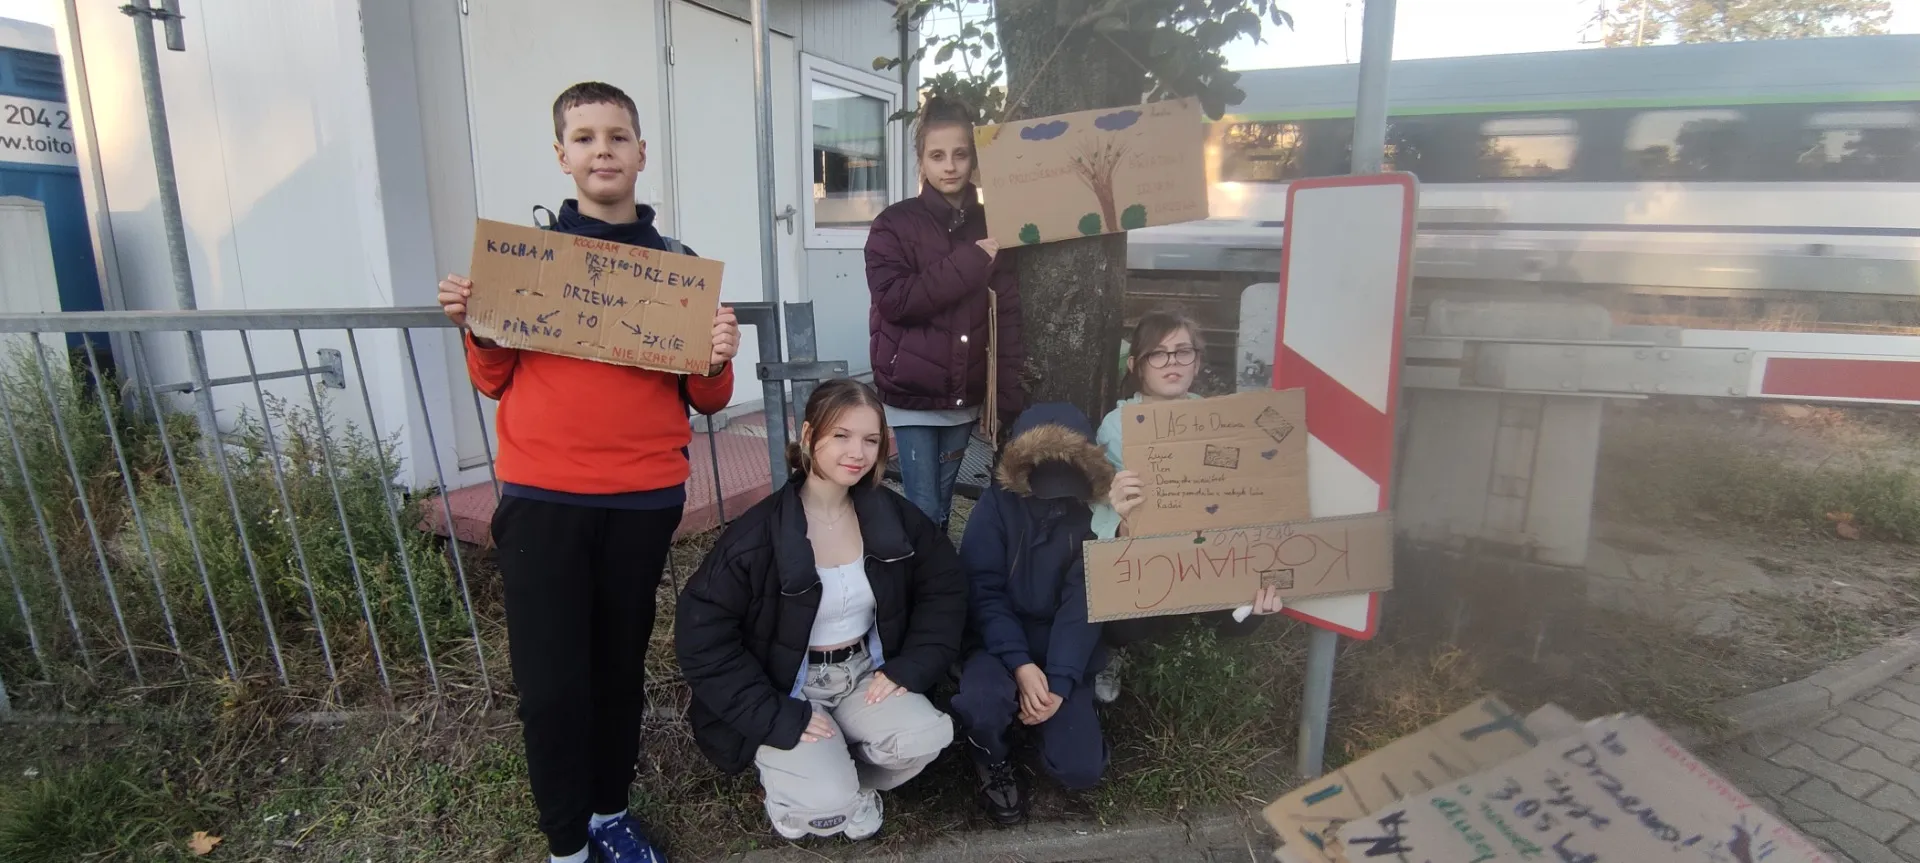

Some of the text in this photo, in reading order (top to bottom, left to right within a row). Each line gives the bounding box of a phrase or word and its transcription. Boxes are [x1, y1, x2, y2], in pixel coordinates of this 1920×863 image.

[5, 104, 51, 128] 204
[487, 240, 554, 261] KOCHAM
[573, 237, 619, 253] KOCHAM
[563, 283, 627, 307] DRZEWA
[612, 347, 633, 360] NIE
[1153, 409, 1187, 440] LAS
[1192, 416, 1205, 432] to
[812, 816, 844, 828] SKATER
